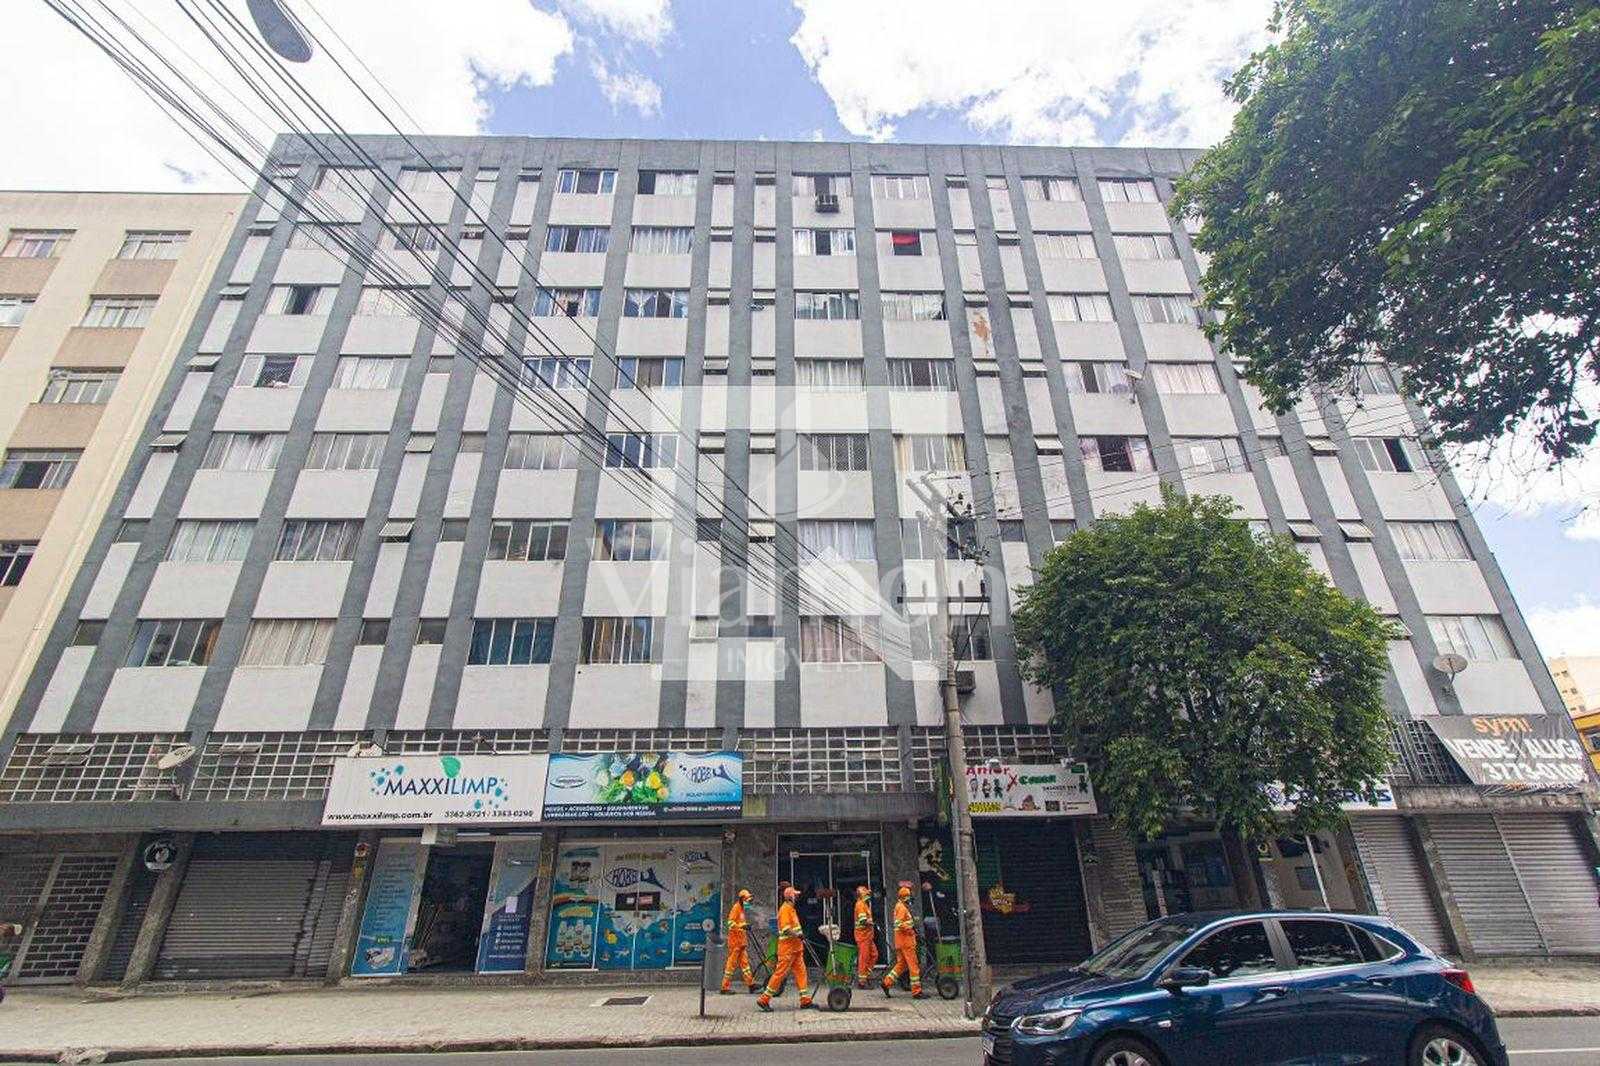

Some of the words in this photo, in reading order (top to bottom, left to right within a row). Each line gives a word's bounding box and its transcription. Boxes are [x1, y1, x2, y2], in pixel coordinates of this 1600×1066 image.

[1448, 738, 1517, 759] VENDE
[1524, 738, 1584, 759] ALUGA
[383, 776, 498, 796] MAXXILIMP
[327, 811, 433, 821] www.maxxilimp.com.br
